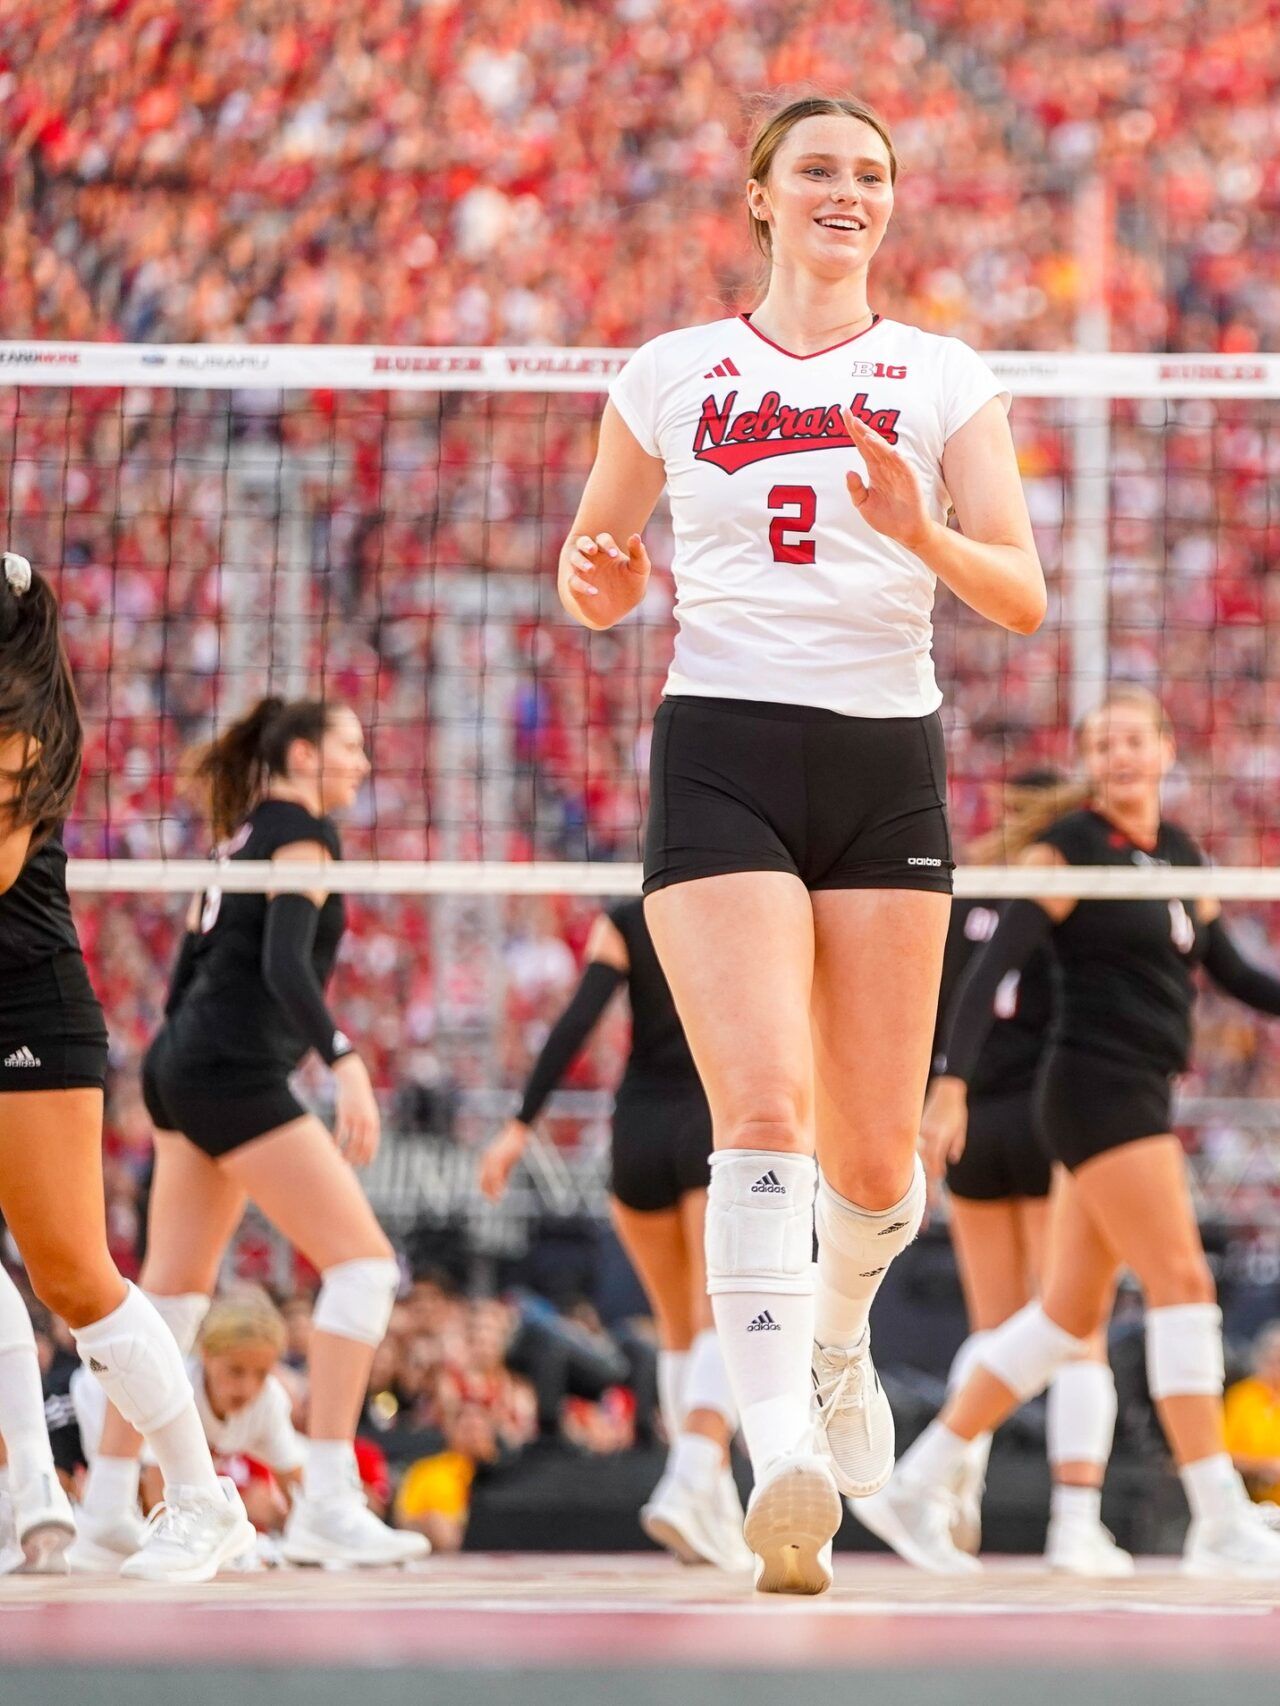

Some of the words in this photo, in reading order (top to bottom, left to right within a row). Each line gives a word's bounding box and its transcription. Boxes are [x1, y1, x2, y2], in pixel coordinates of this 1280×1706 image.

[692, 390, 900, 453] Nebraska
[767, 484, 817, 564] 2
[907, 857, 942, 867] adidas
[751, 1183, 786, 1194] adidas
[747, 1322, 782, 1332] adidas
